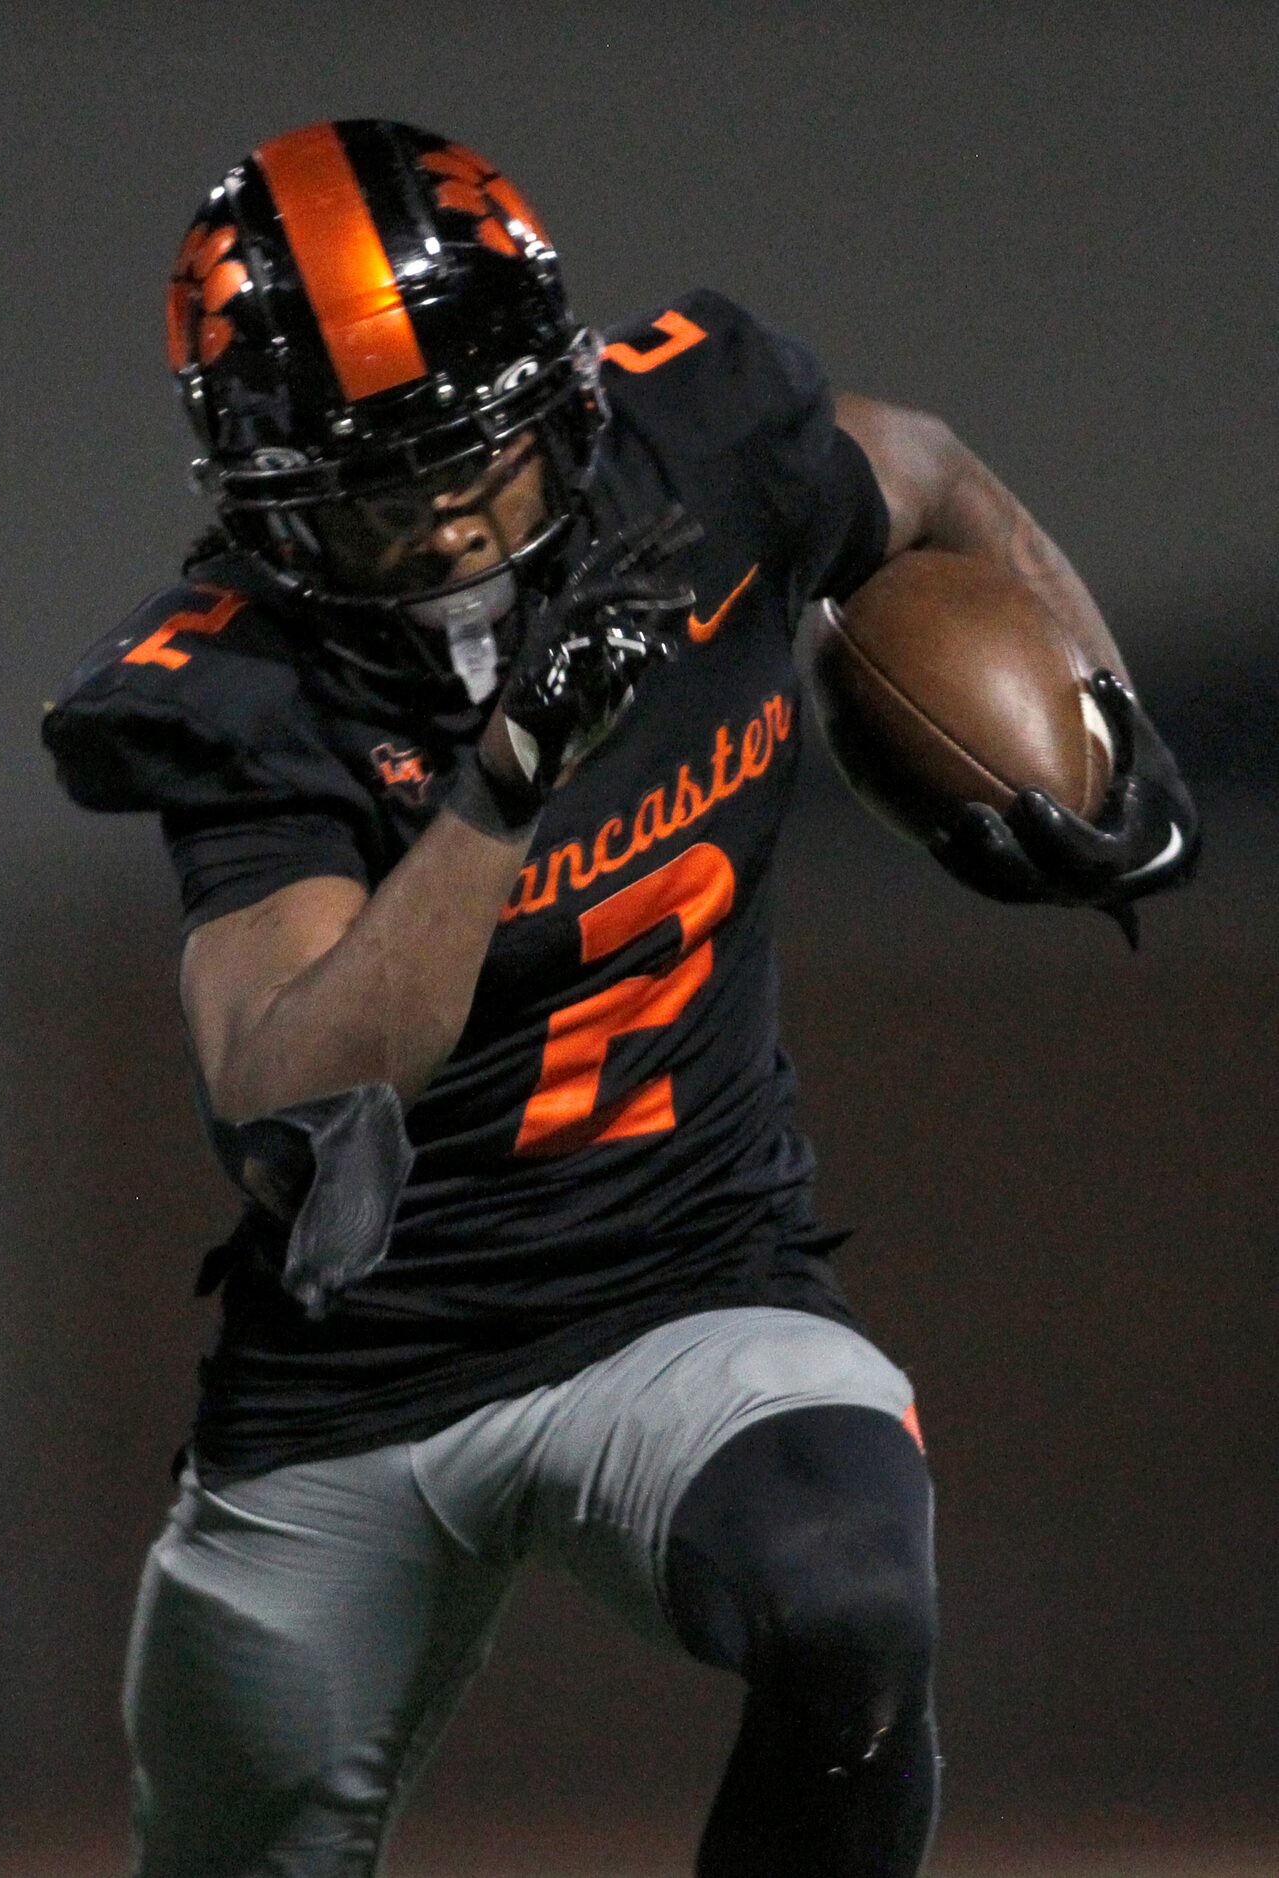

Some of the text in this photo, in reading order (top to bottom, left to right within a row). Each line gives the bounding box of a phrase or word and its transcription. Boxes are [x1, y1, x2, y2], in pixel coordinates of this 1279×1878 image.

[122, 583, 249, 671] 2
[498, 694, 793, 923] ancaster
[513, 842, 736, 1157] 2
